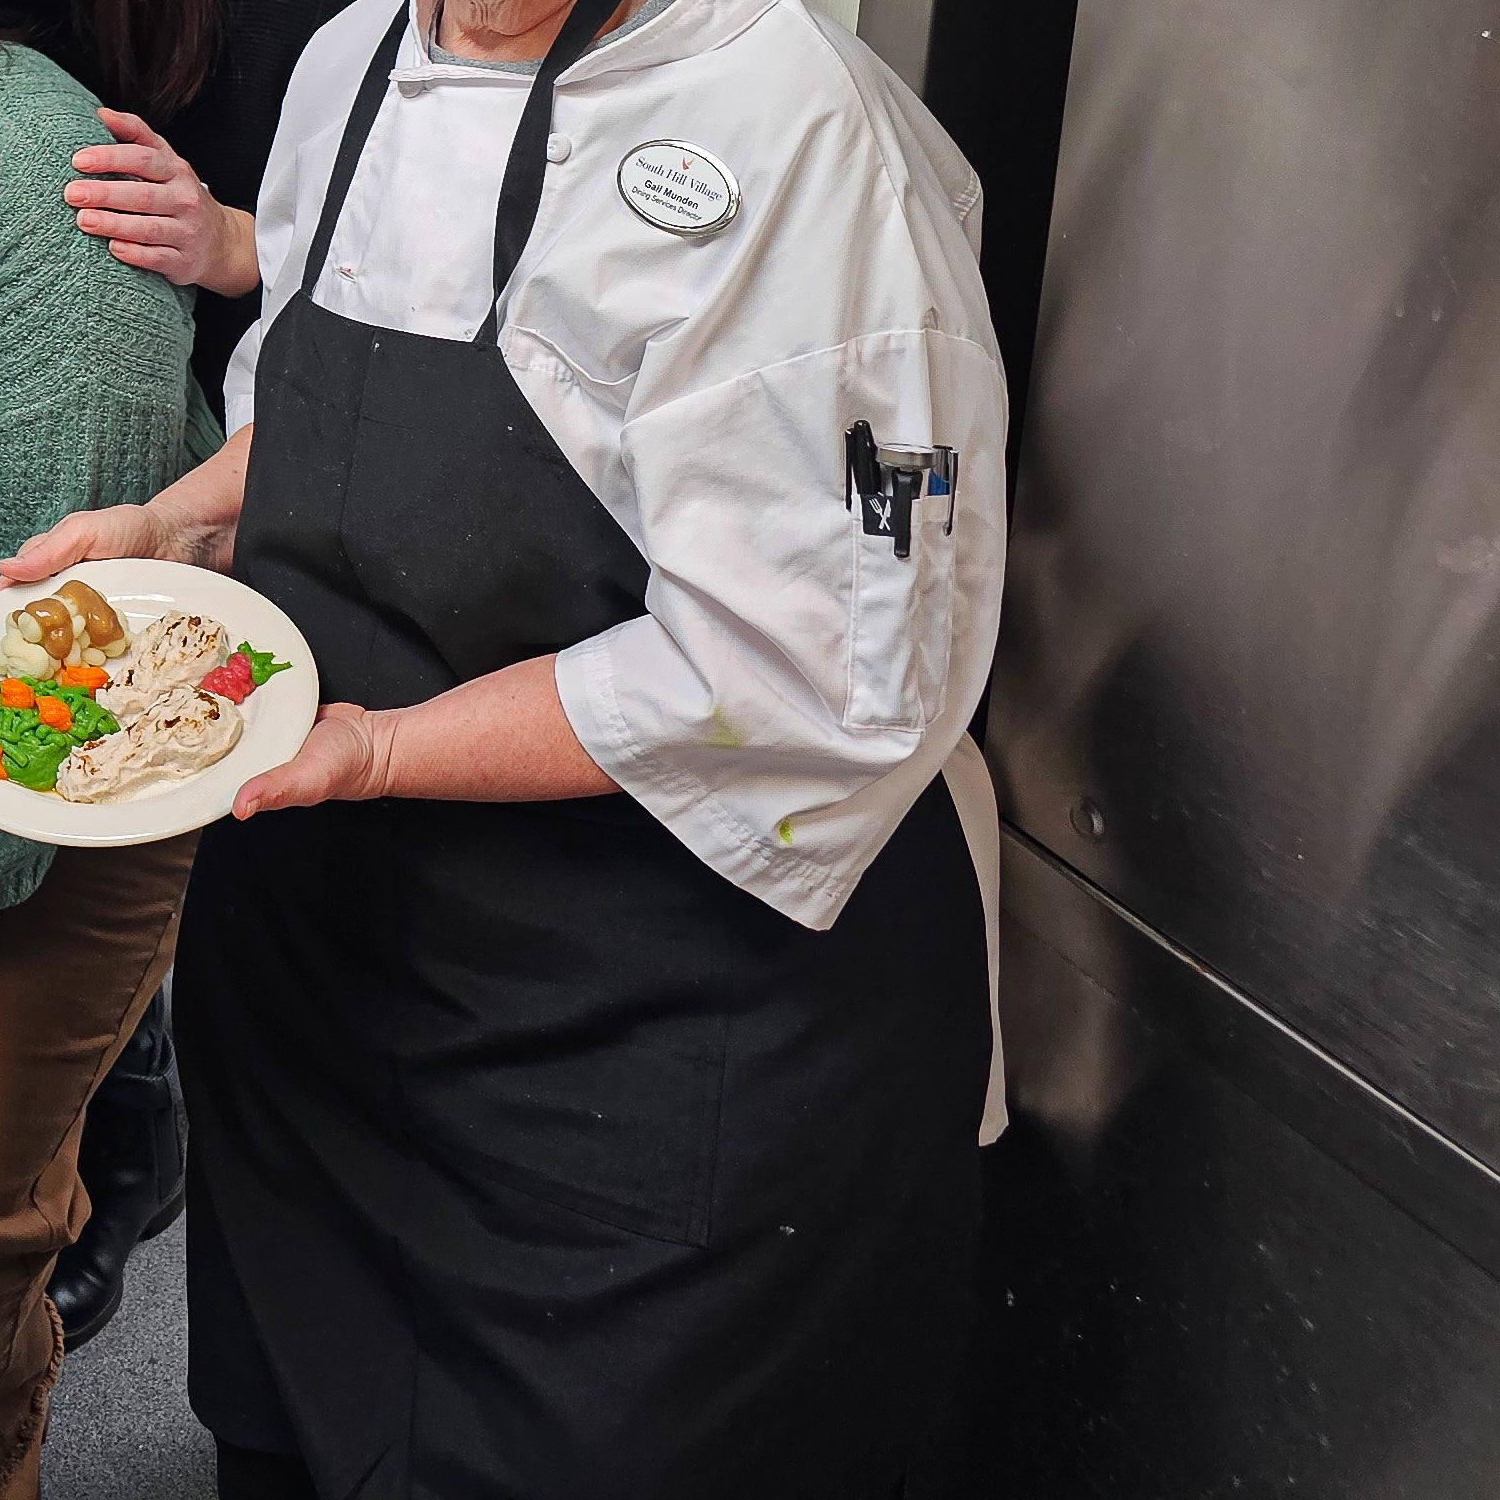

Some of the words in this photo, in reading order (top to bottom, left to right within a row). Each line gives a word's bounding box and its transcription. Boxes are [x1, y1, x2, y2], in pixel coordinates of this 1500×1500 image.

[636, 157, 664, 176] South
[666, 169, 688, 186] Hill
[690, 178, 722, 201] Village
[631, 186, 651, 201] Dining
[663, 187, 699, 210] Munden
